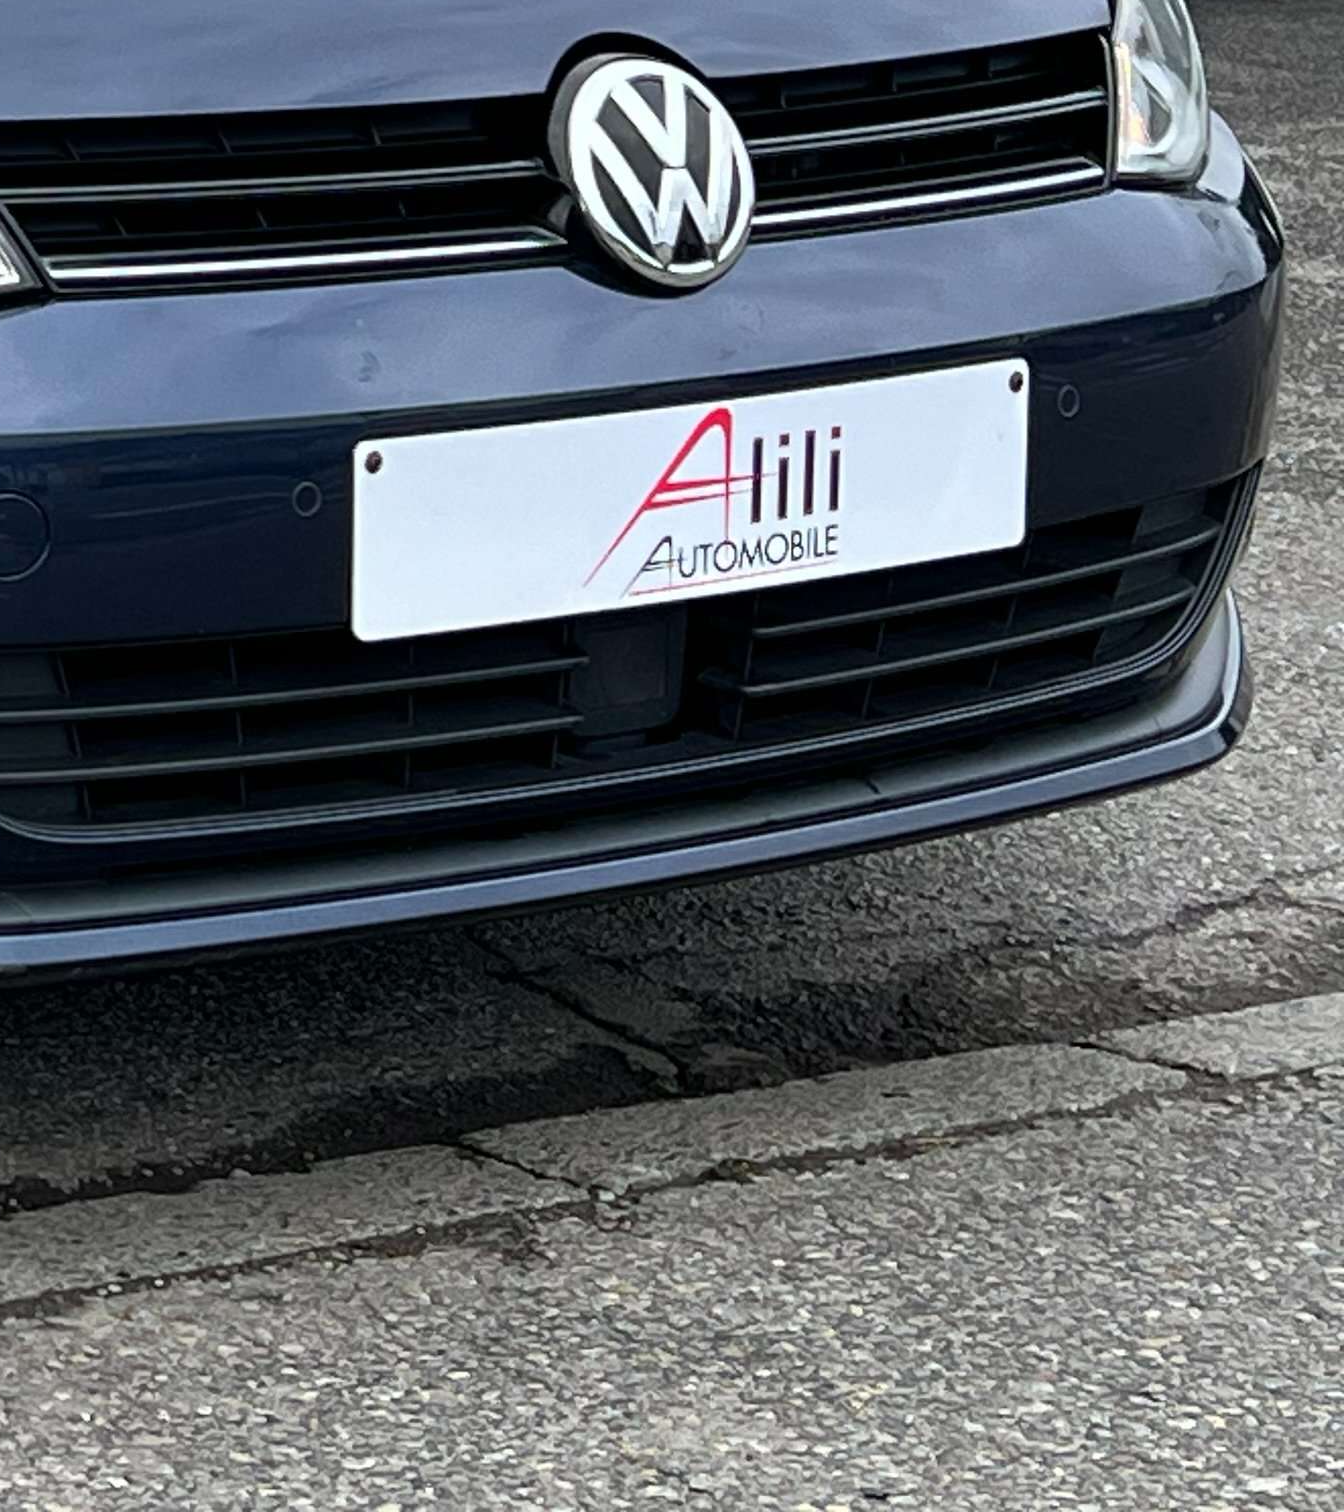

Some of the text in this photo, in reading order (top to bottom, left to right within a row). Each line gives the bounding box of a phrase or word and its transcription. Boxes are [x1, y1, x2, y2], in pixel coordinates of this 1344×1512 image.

[566, 58, 754, 280] VW
[583, 406, 842, 592] Alili
[621, 524, 840, 596] AUTOMOBILE
